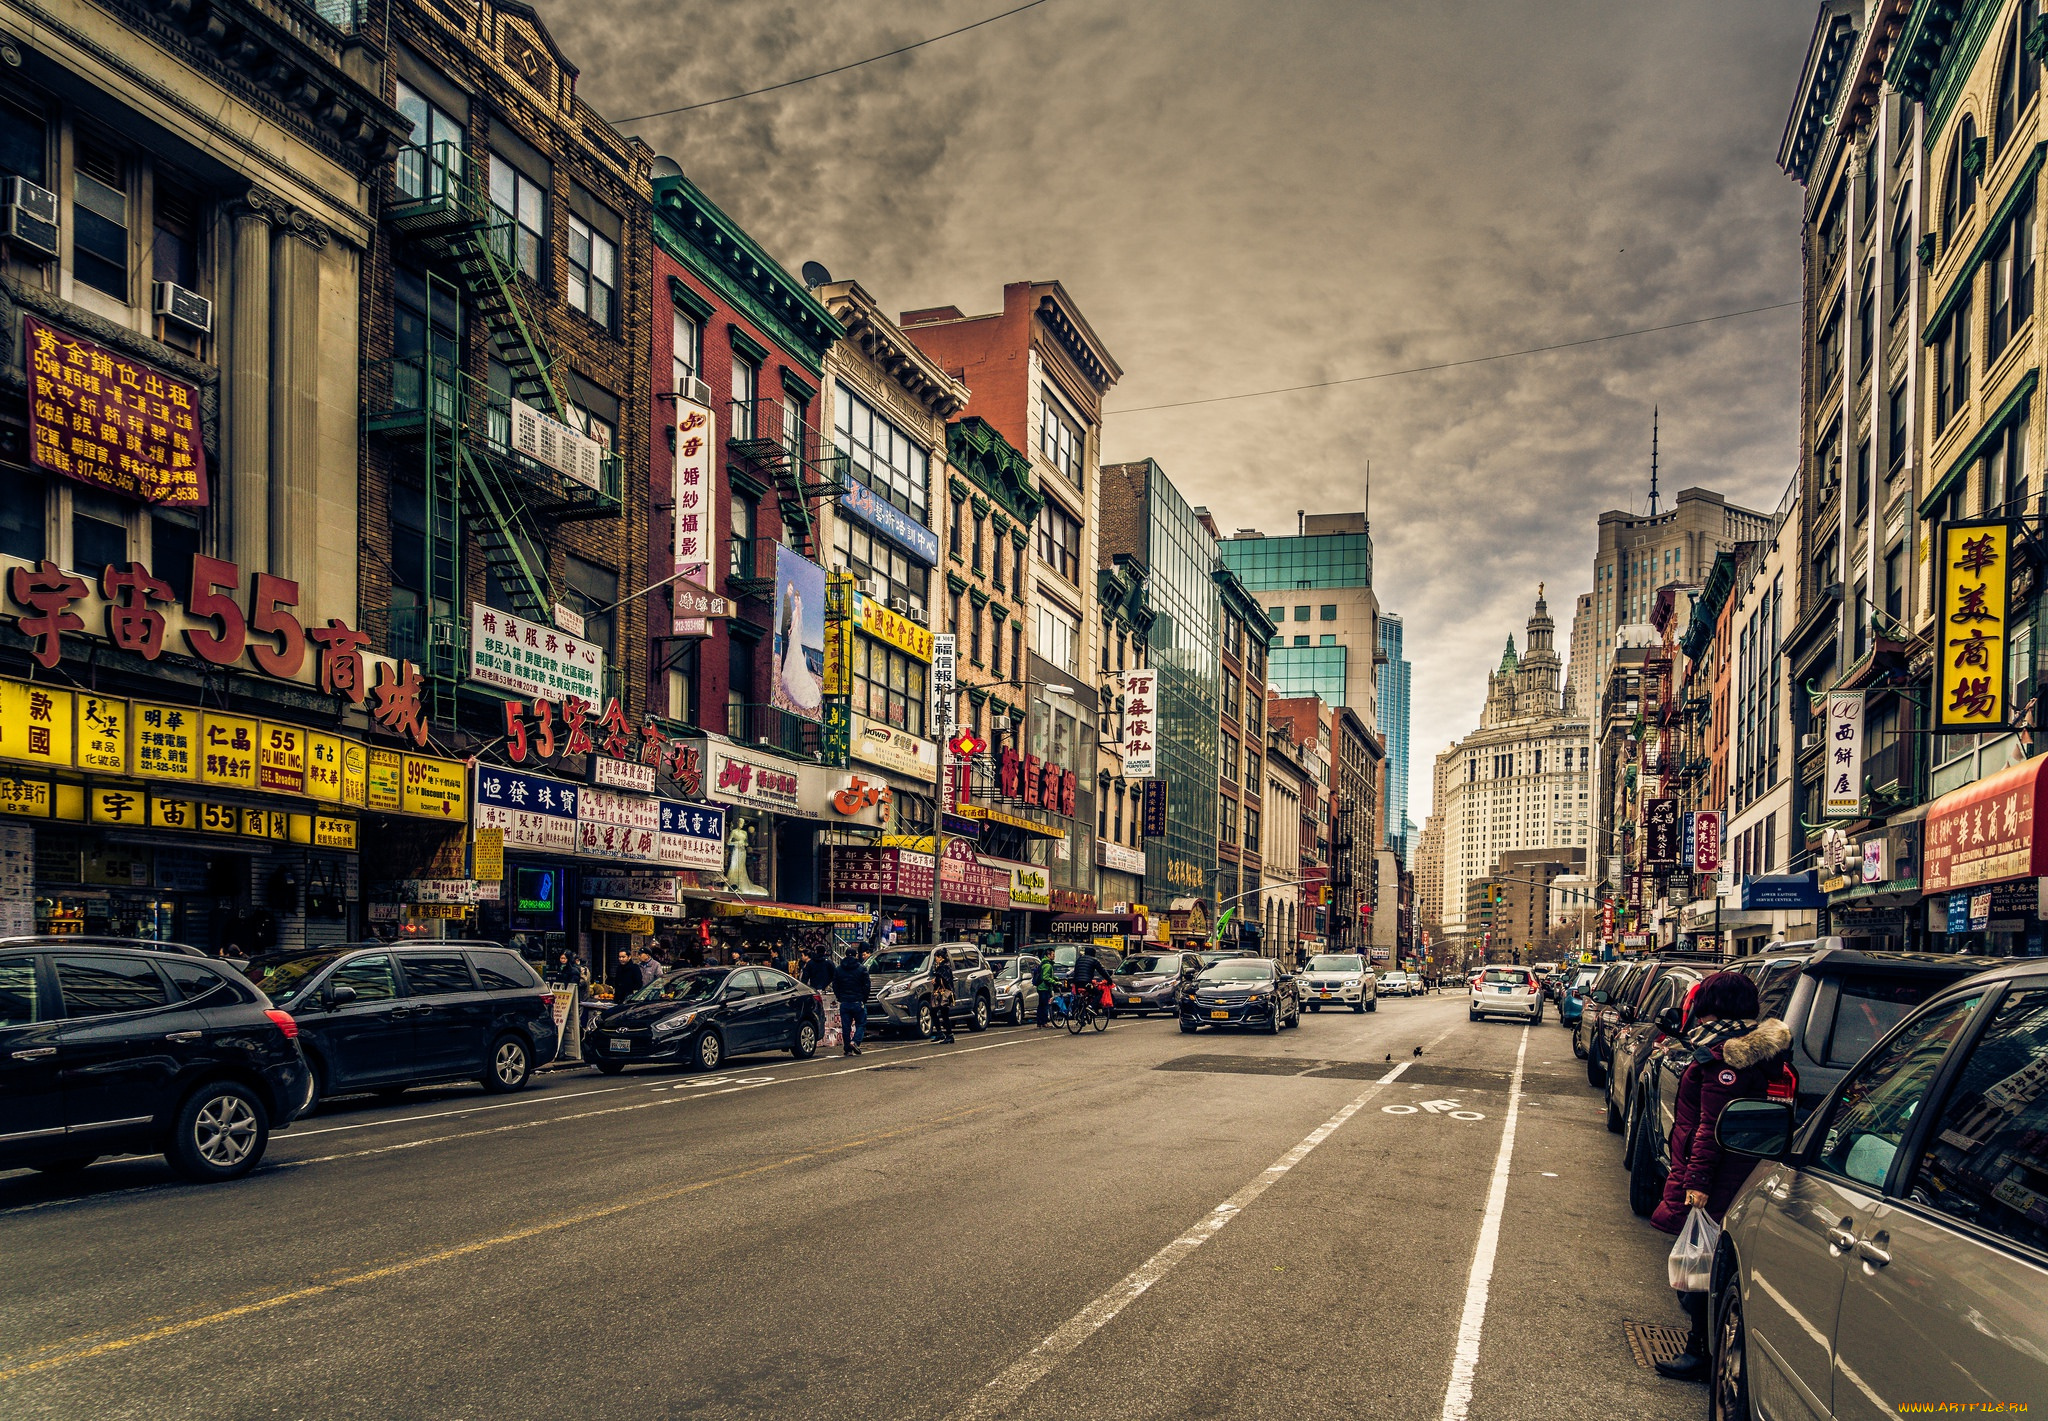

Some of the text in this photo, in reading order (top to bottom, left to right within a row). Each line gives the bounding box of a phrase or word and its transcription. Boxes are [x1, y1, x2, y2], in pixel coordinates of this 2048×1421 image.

[681, 466, 700, 557] 婚紗攝影
[874, 502, 935, 555] 藝術培訓中心
[864, 605, 933, 660] 中國社會民主黨
[1950, 533, 2000, 718] 華美商場
[483, 612, 595, 664] 精誠服務中心
[11, 553, 428, 747] 宇宙55商城
[485, 637, 593, 683] 移民入籍 房屋貸款 社區福利
[475, 651, 599, 699] 翻譯公證 商業貸款 免費政府醫療卡
[909, 671, 922, 692] 301
[543, 688, 555, 699] TEL:
[1126, 677, 1153, 757] 福華傢俬
[1832, 700, 1861, 719] QQ
[144, 709, 185, 732] 明華
[91, 740, 116, 753] 精品
[141, 731, 188, 749] 手機電腦
[207, 724, 251, 752] 仁晶
[270, 729, 295, 751] 55
[85, 754, 120, 767] 化妝品
[141, 746, 188, 764] 維修、銷售
[262, 749, 303, 769] FU MEI INC.
[1834, 724, 1854, 794] 西餅屋
[206, 755, 251, 779] 珠寶金行
[408, 760, 427, 786] 99¢
[428, 763, 439, 773] Plus
[275, 772, 302, 789] Broadway
[757, 770, 797, 794] 婚紗攝影
[421, 787, 445, 801] Discount
[483, 777, 575, 814] 恒發珠寶
[582, 792, 603, 808] 九龍
[102, 792, 286, 839] 宇宙55商城
[421, 803, 440, 812] Basement
[486, 808, 506, 823] 福仁
[749, 799, 774, 811] BROADWAY
[319, 820, 352, 834] 華美百貨
[1651, 812, 1674, 824] 永昌
[1957, 792, 2018, 851] 華美商場
[1699, 820, 1709, 864] 漂亮人生
[1960, 849, 1984, 862] INTERNATIONAL
[1984, 845, 1997, 858] GROUP
[1997, 841, 2014, 854] TRADING
[1017, 869, 1033, 889] Yung
[1034, 871, 1044, 888] Sun
[1825, 879, 1842, 890] BAKERY
[1051, 922, 1119, 933] CATHAY BANK
